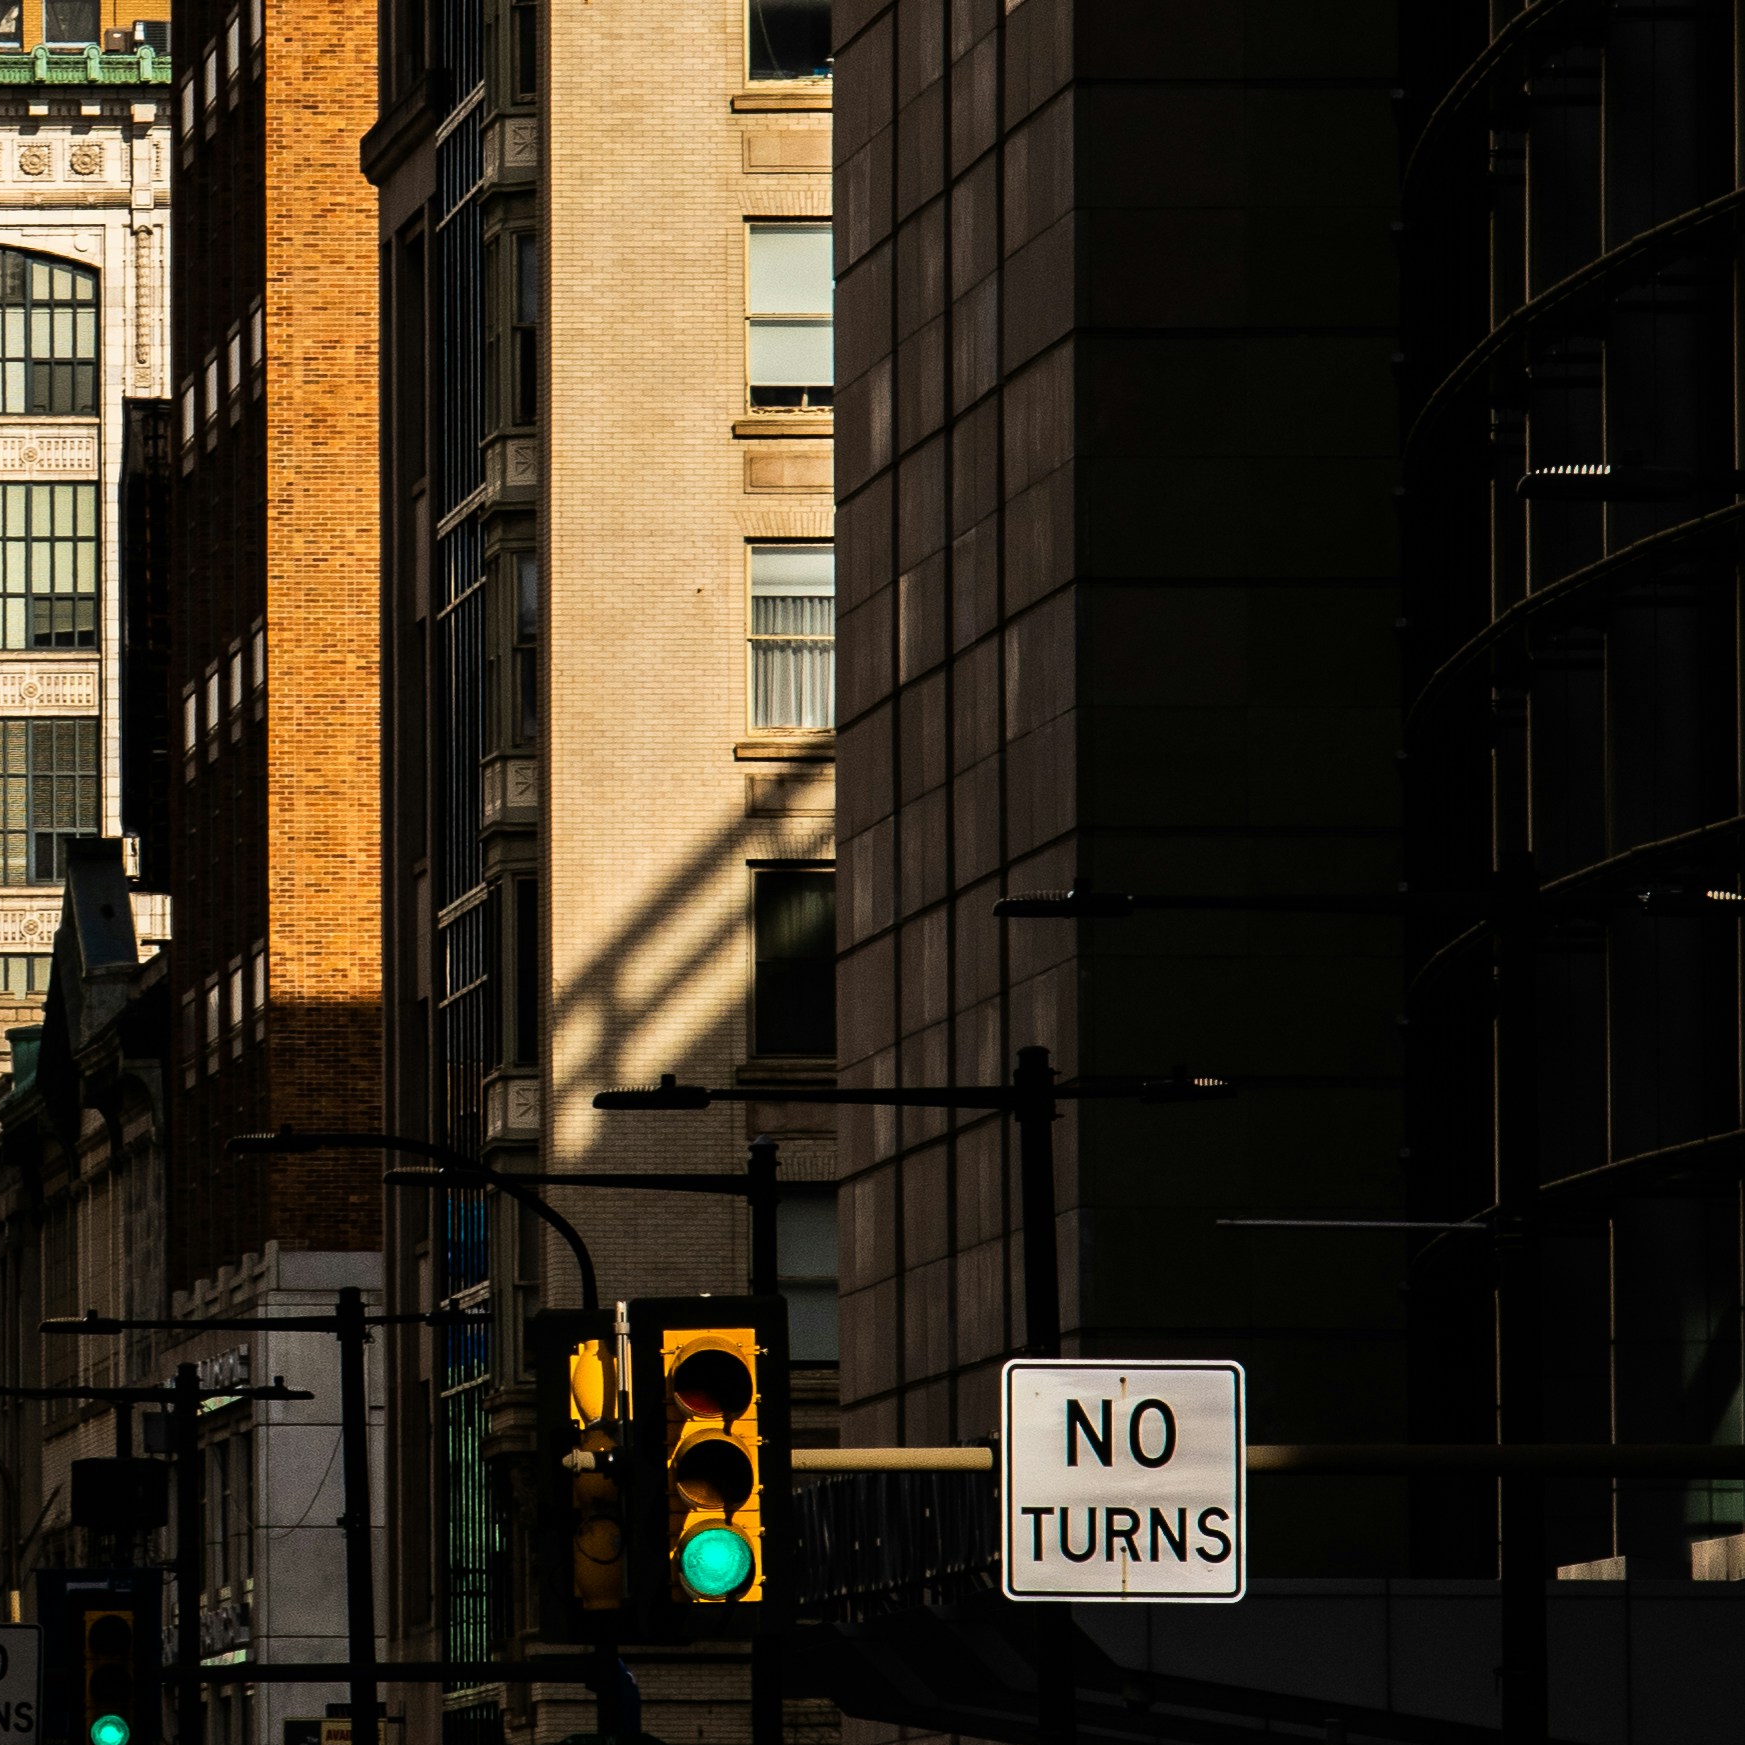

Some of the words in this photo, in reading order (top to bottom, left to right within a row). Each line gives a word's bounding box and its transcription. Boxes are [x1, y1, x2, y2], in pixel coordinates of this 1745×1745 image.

[1066, 1399, 1175, 1467] NO
[1021, 1506, 1231, 1562] TURNS
[326, 1729, 353, 1742] AVAI
